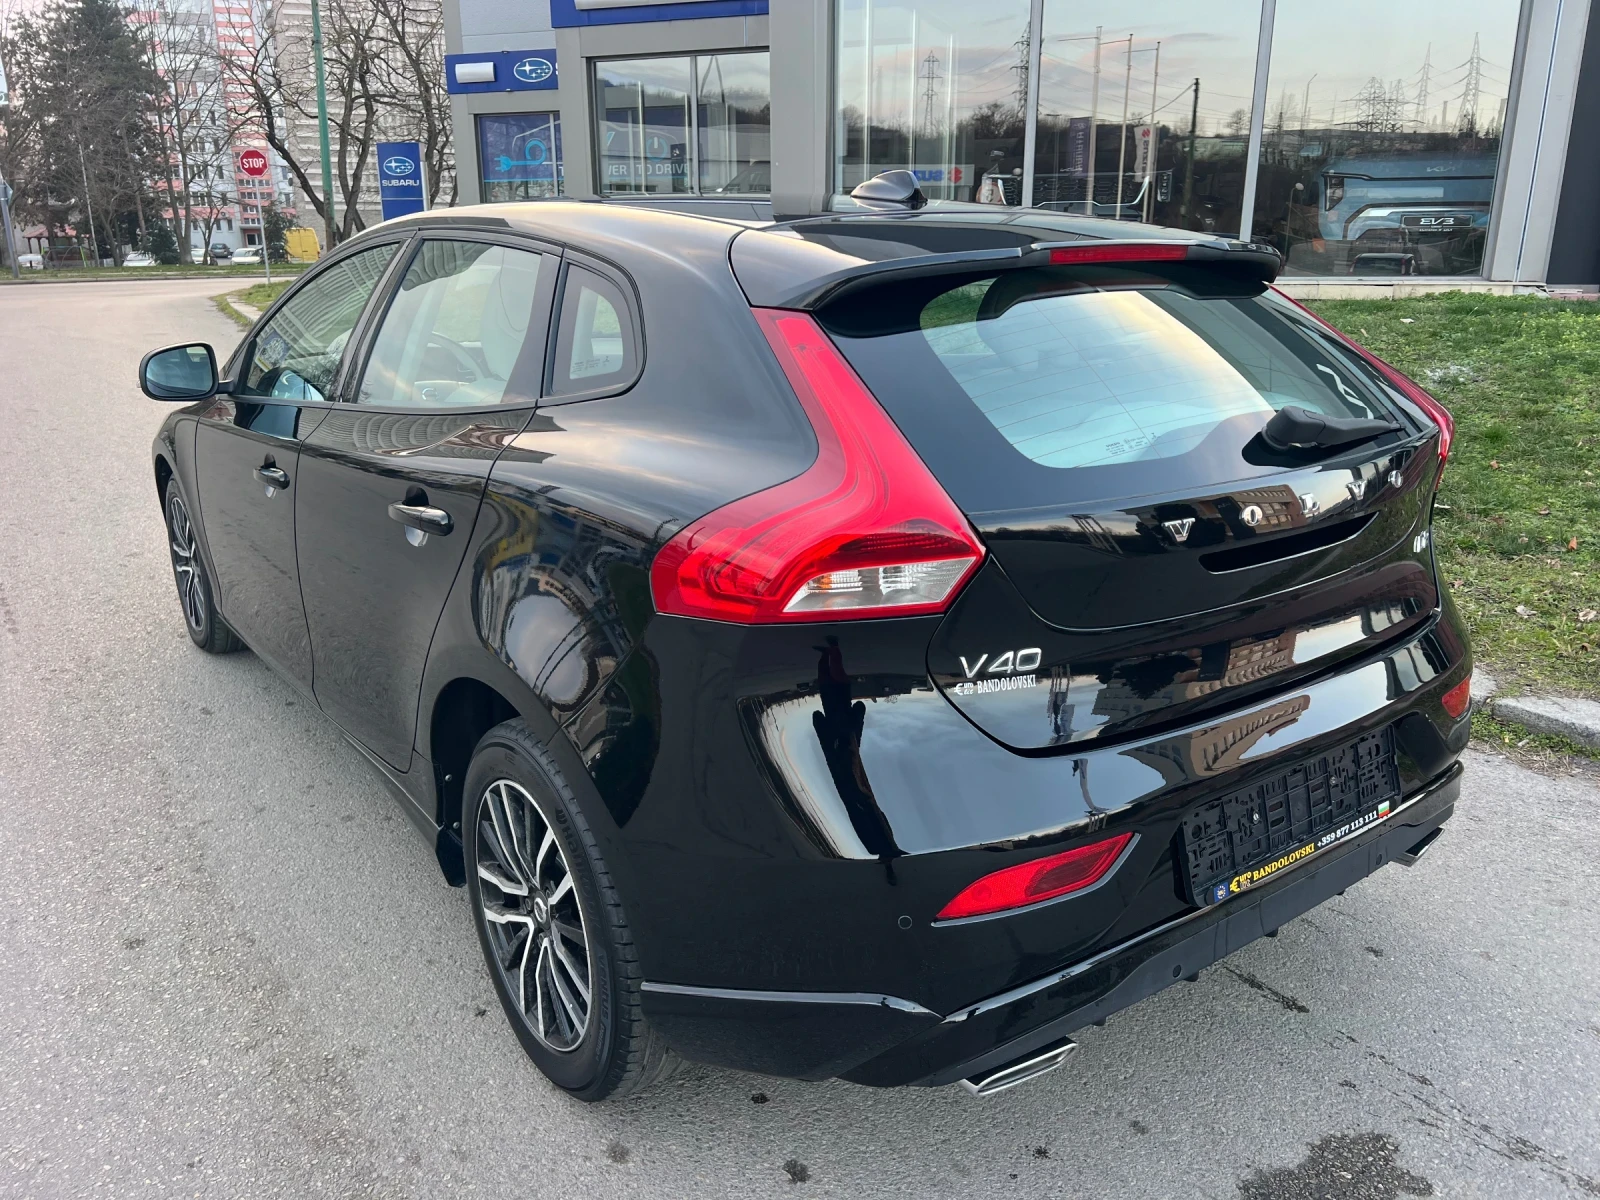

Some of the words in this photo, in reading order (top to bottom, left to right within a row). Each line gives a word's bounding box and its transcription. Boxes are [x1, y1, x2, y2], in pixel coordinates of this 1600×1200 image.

[242, 158, 265, 168] STOP
[381, 179, 420, 187] SUBARU
[1161, 469, 1404, 542] VOLVO
[959, 648, 1042, 679] V40
[977, 674, 1037, 694] BANDOLOVSKI
[1252, 842, 1315, 881] BANDOLOVSKI
[1317, 832, 1336, 848] +359
[1336, 825, 1350, 838] 877
[1350, 818, 1364, 831] 113
[1364, 810, 1378, 823] 111
